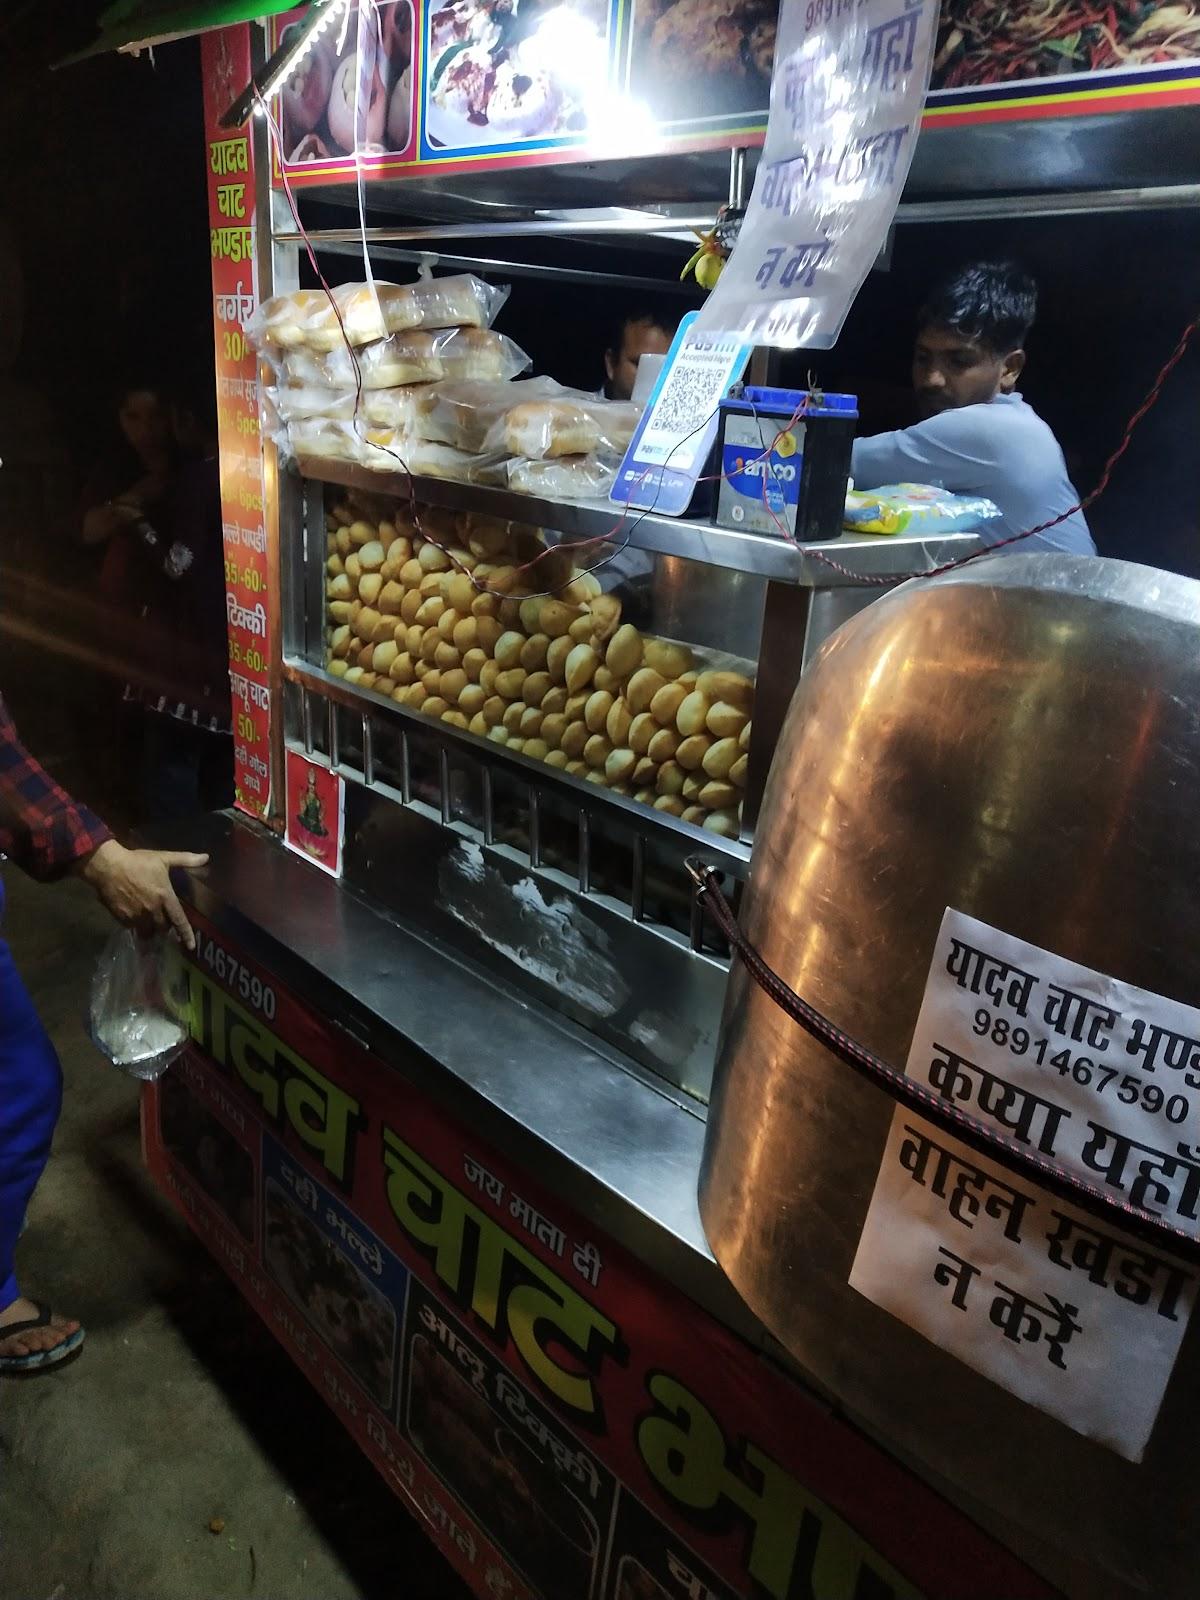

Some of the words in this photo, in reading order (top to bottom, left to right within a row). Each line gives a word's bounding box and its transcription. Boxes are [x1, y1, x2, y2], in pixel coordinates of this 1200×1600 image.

[210, 138, 248, 175] यादव
[217, 184, 246, 218] चाट
[211, 226, 257, 263] भण्डार
[215, 281, 254, 323] बर्गर
[226, 592, 266, 638] टिक्की
[238, 713, 261, 744] 50/-
[250, 681, 270, 711] चाट
[946, 937, 1040, 1019] यादव
[1042, 983, 1122, 1052] चाट
[971, 1008, 1190, 1125] 9891467590
[463, 1153, 505, 1206] जय
[509, 1192, 567, 1259] माता
[572, 1239, 603, 1289] दी
[899, 1124, 1036, 1245] वाहन
[383, 1126, 617, 1413] चाट
[933, 1246, 981, 1313] न
[988, 1280, 1083, 1371] करें
[418, 1303, 490, 1401] आलू
[495, 1371, 602, 1500] टिक्की
